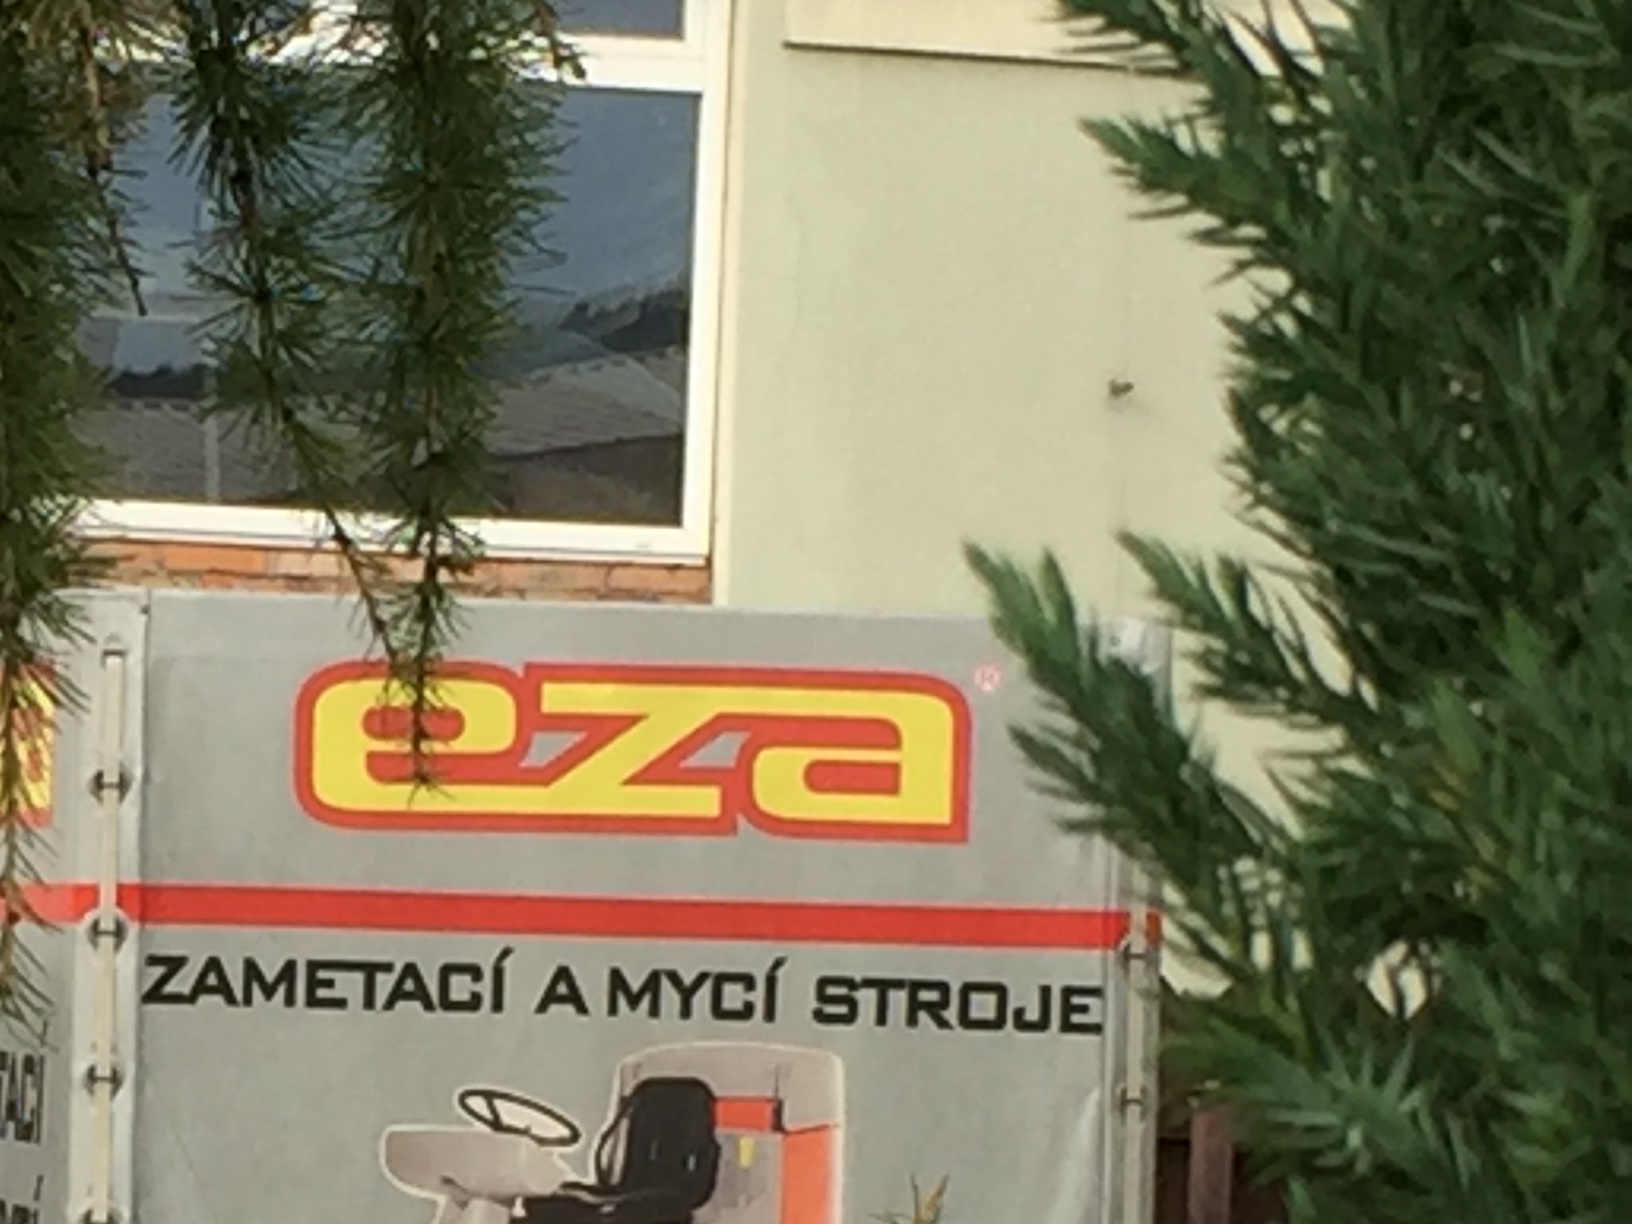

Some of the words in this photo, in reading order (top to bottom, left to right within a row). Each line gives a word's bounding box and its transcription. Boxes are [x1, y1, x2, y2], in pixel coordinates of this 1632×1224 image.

[294, 660, 970, 843] eza
[141, 948, 512, 1016] ZAMETACÍ
[536, 966, 588, 1016] A
[609, 957, 783, 1024] MYCÍ
[813, 977, 1104, 1034] STROJE
